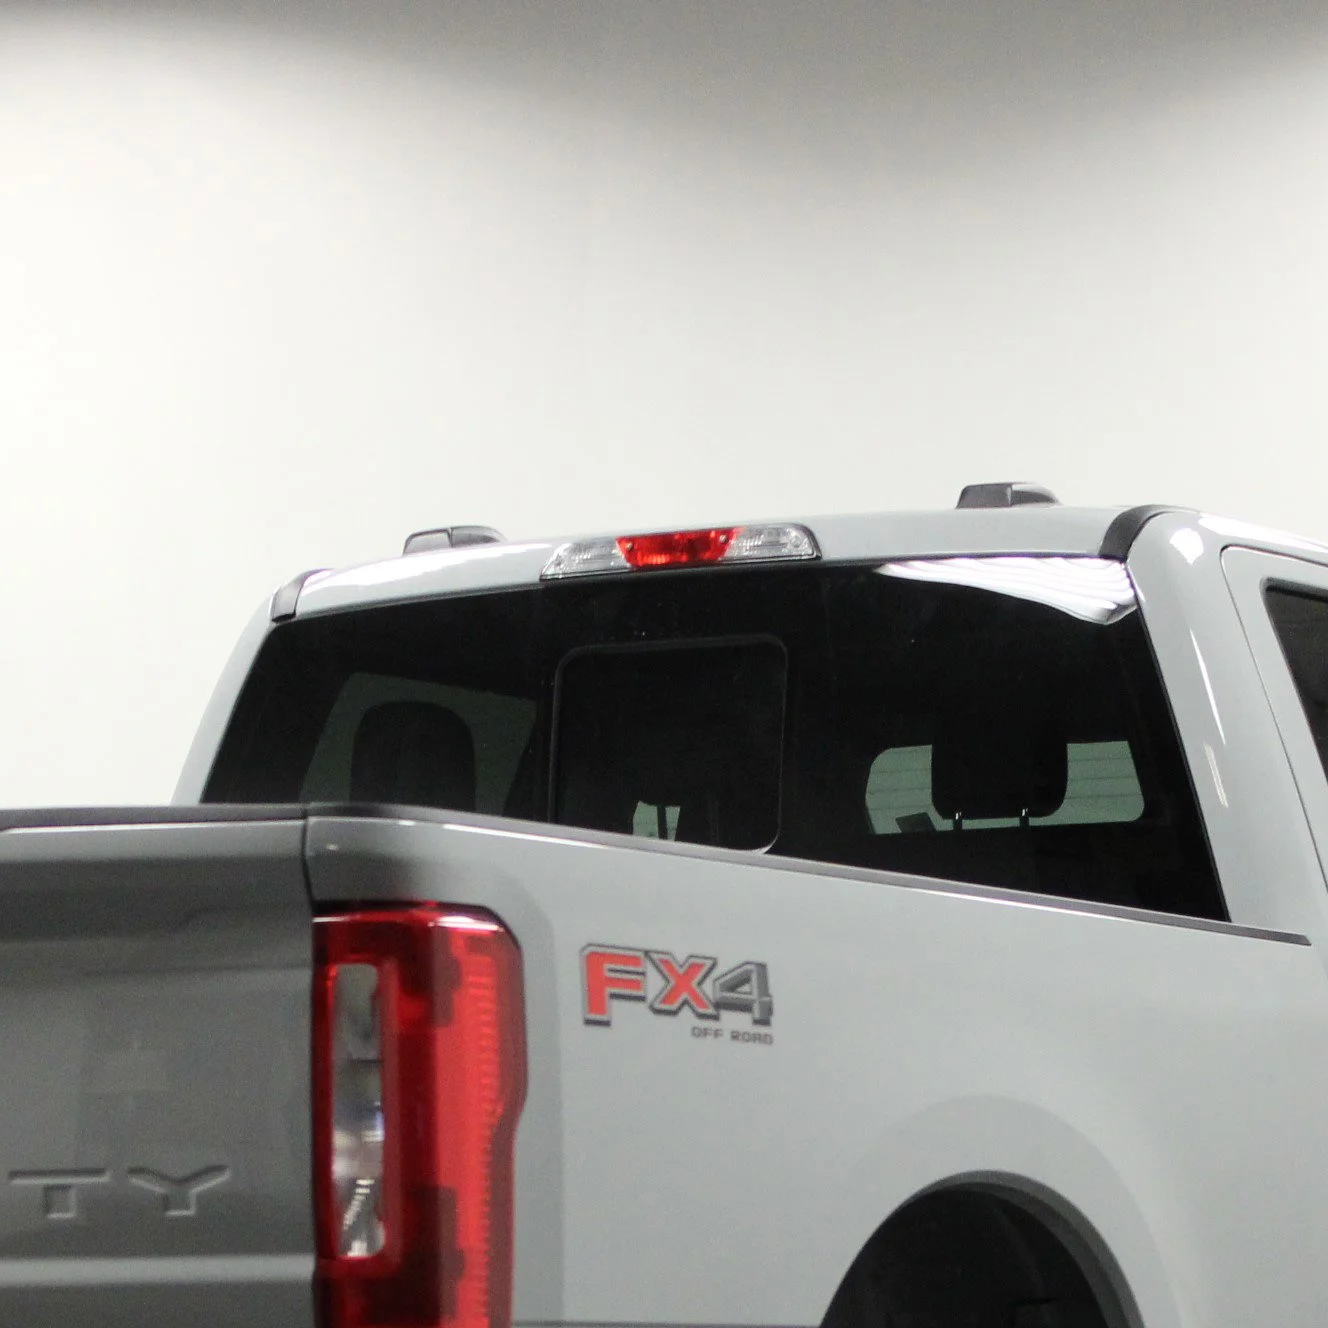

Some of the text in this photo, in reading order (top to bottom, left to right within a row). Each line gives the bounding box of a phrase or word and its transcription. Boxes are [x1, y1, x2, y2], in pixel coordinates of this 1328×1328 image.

[579, 943, 773, 1028] FX4
[690, 1026, 774, 1045] OFF ROAD
